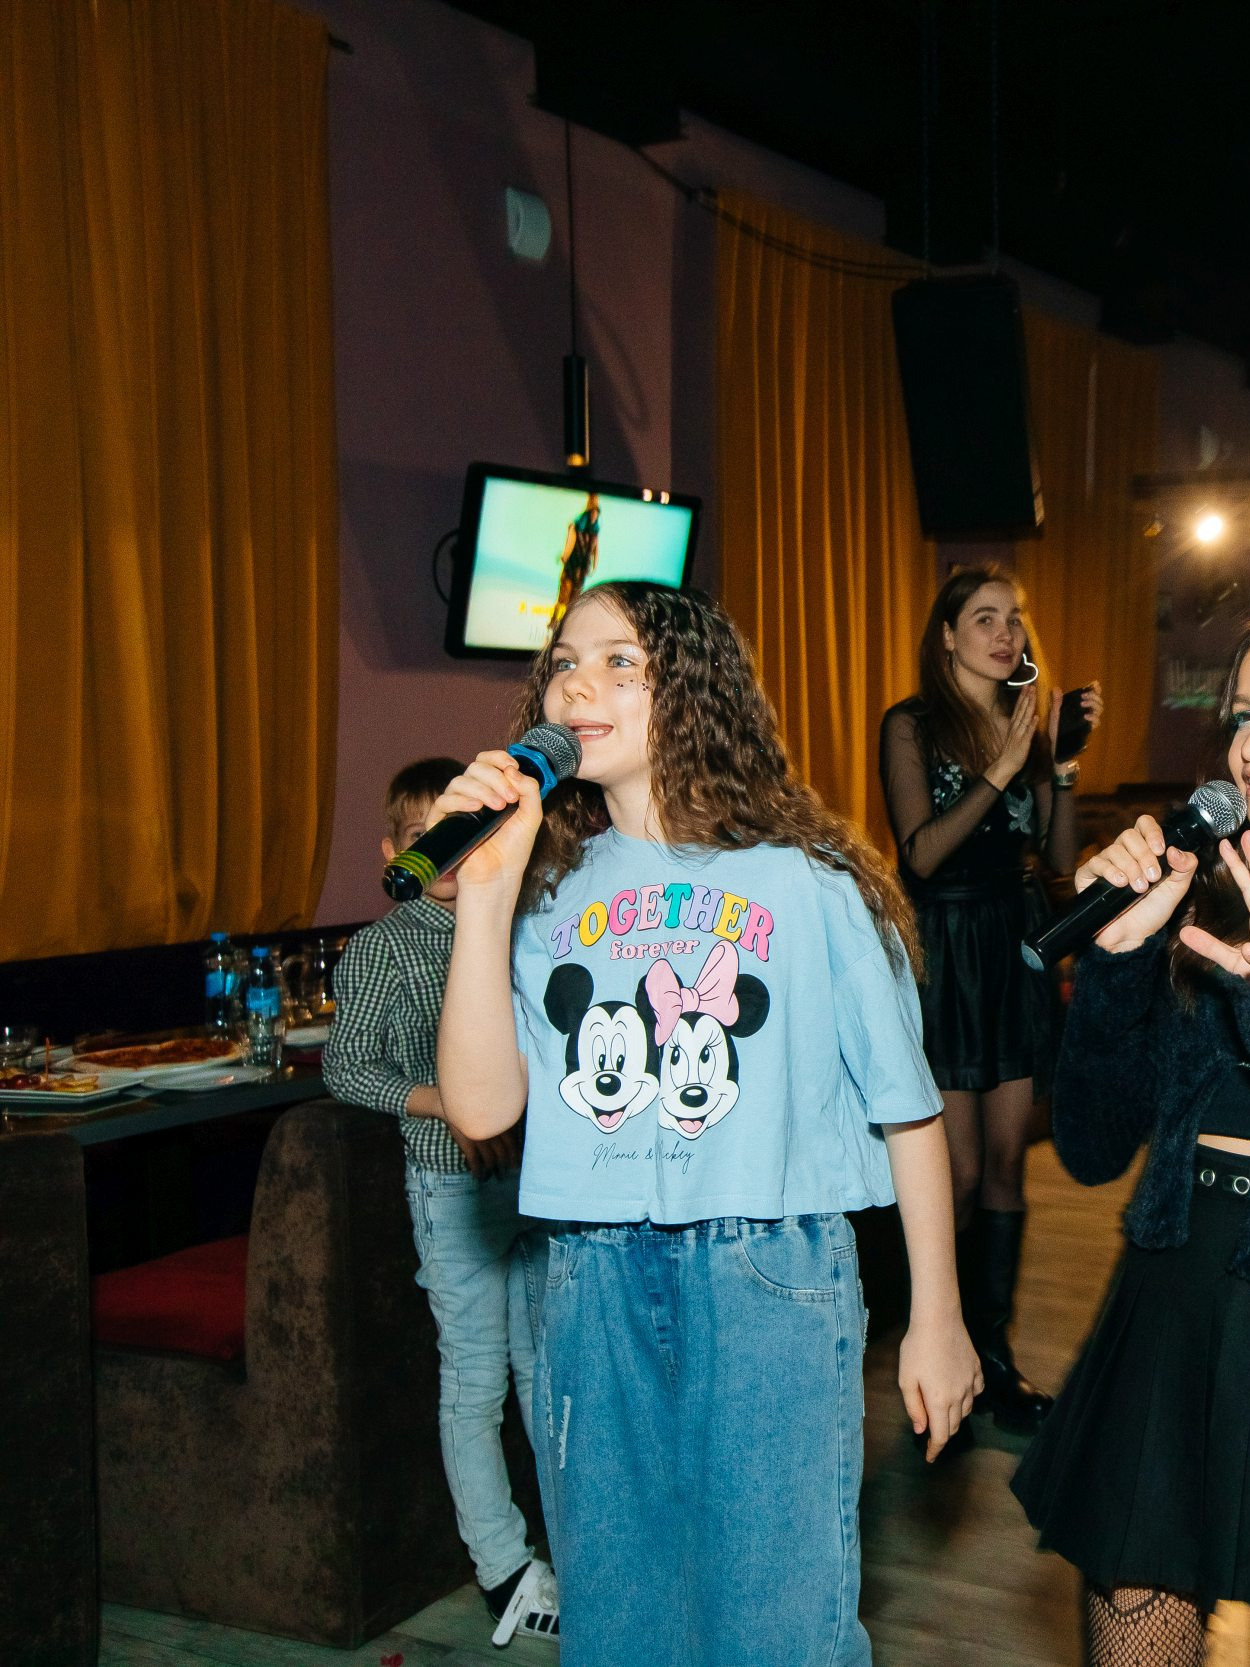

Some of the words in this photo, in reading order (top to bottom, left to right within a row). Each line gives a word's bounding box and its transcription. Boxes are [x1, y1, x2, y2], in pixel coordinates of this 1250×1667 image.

[551, 882, 774, 962] TOGETHER
[609, 940, 700, 960] forever
[591, 1142, 639, 1171] Minnie
[645, 1147, 654, 1160] &
[655, 1140, 695, 1175] ckey
